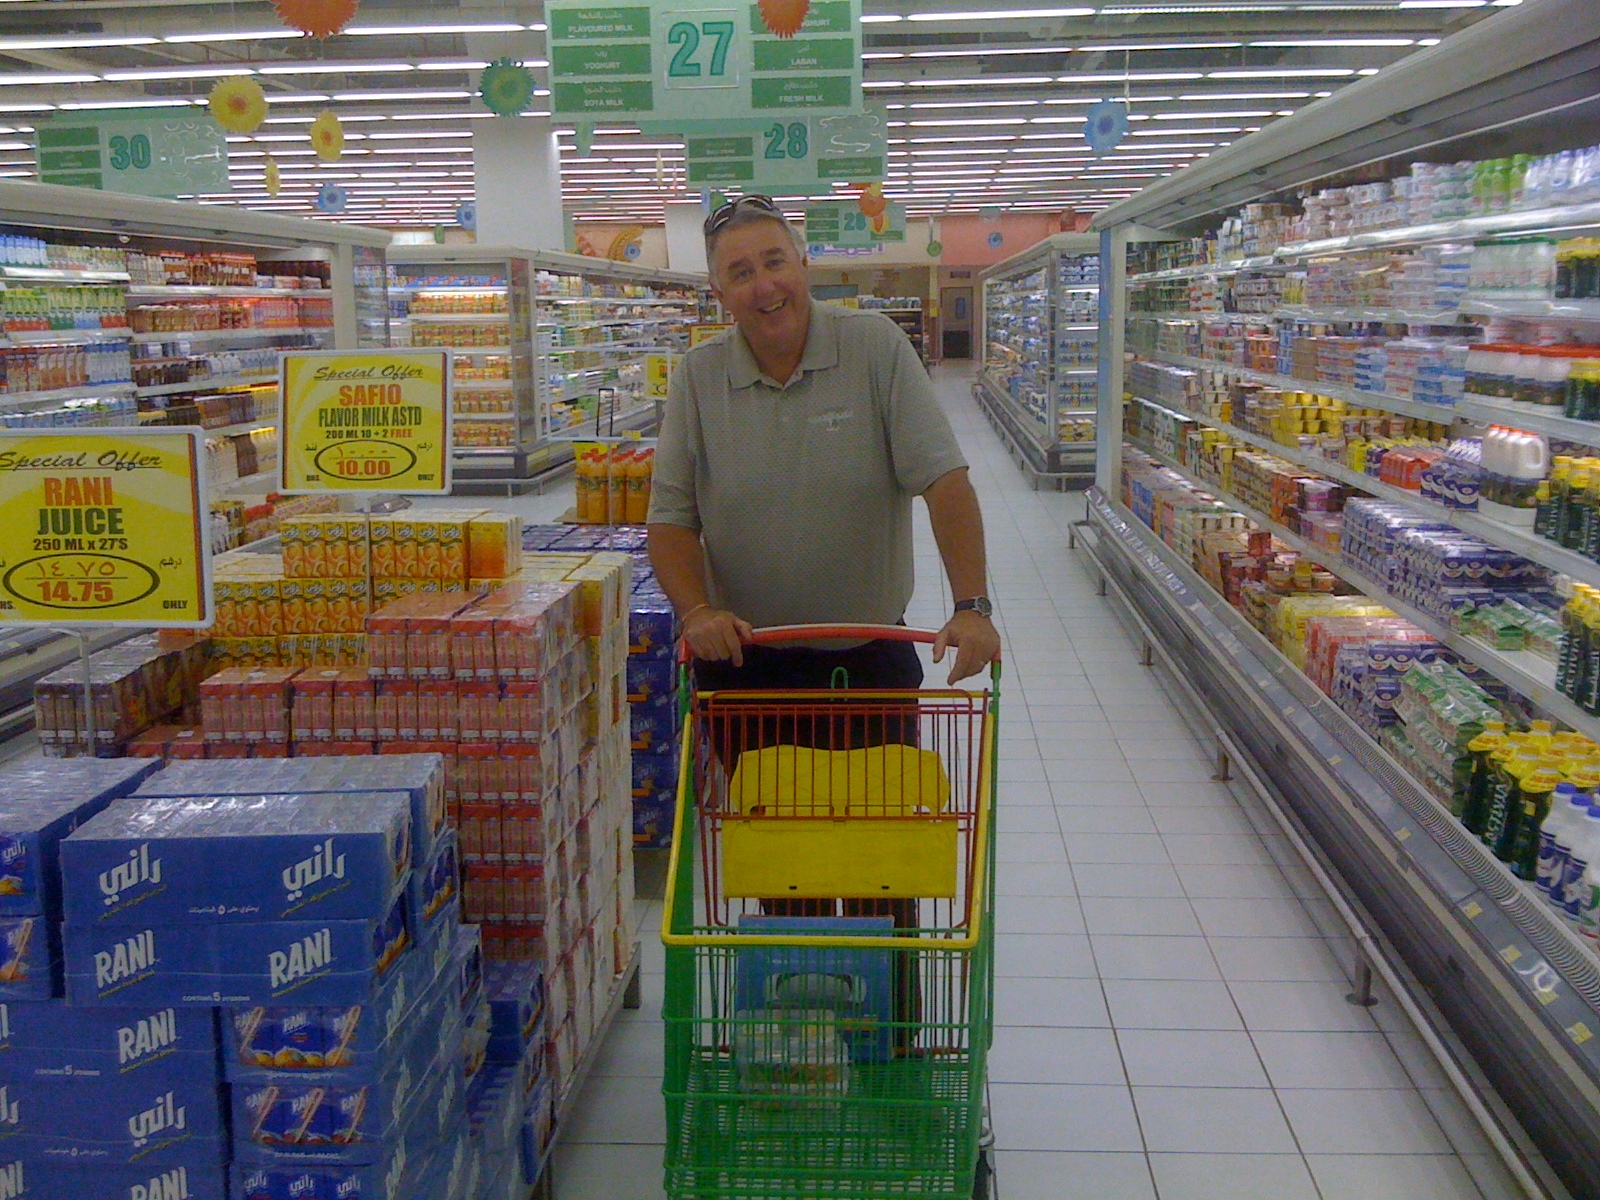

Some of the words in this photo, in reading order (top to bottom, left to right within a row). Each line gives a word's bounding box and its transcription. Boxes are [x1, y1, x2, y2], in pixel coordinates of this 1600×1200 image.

[667, 20, 735, 77] 27
[108, 134, 151, 170] 30
[764, 122, 808, 159] 28
[314, 366, 376, 381] Special
[381, 365, 424, 381] Offer
[339, 384, 402, 407] SAFIO
[318, 408, 359, 428] FLAVOR
[361, 407, 390, 427] MILK
[391, 406, 422, 427] ASTD
[325, 430, 344, 439] 200
[345, 430, 359, 439] ML
[361, 429, 372, 439] 10
[382, 429, 389, 438] 2
[390, 428, 413, 438] FREE
[0, 451, 87, 472] Special
[97, 450, 163, 472] Offer
[336, 460, 391, 476] 10.00
[417, 473, 435, 481] ONLY
[44, 476, 114, 507] RANI
[37, 508, 125, 536] JUICE
[33, 538, 61, 551] 250
[65, 538, 85, 551] ML
[37, 581, 114, 603] 14.75
[162, 600, 188, 609] ONLY
[99, 842, 163, 906] راني
[282, 838, 347, 901] راني
[94, 929, 156, 989] RANI
[268, 928, 332, 989] RANI
[213, 991, 221, 1002] 5
[118, 1008, 177, 1064] RANI
[129, 1091, 186, 1148] راني
